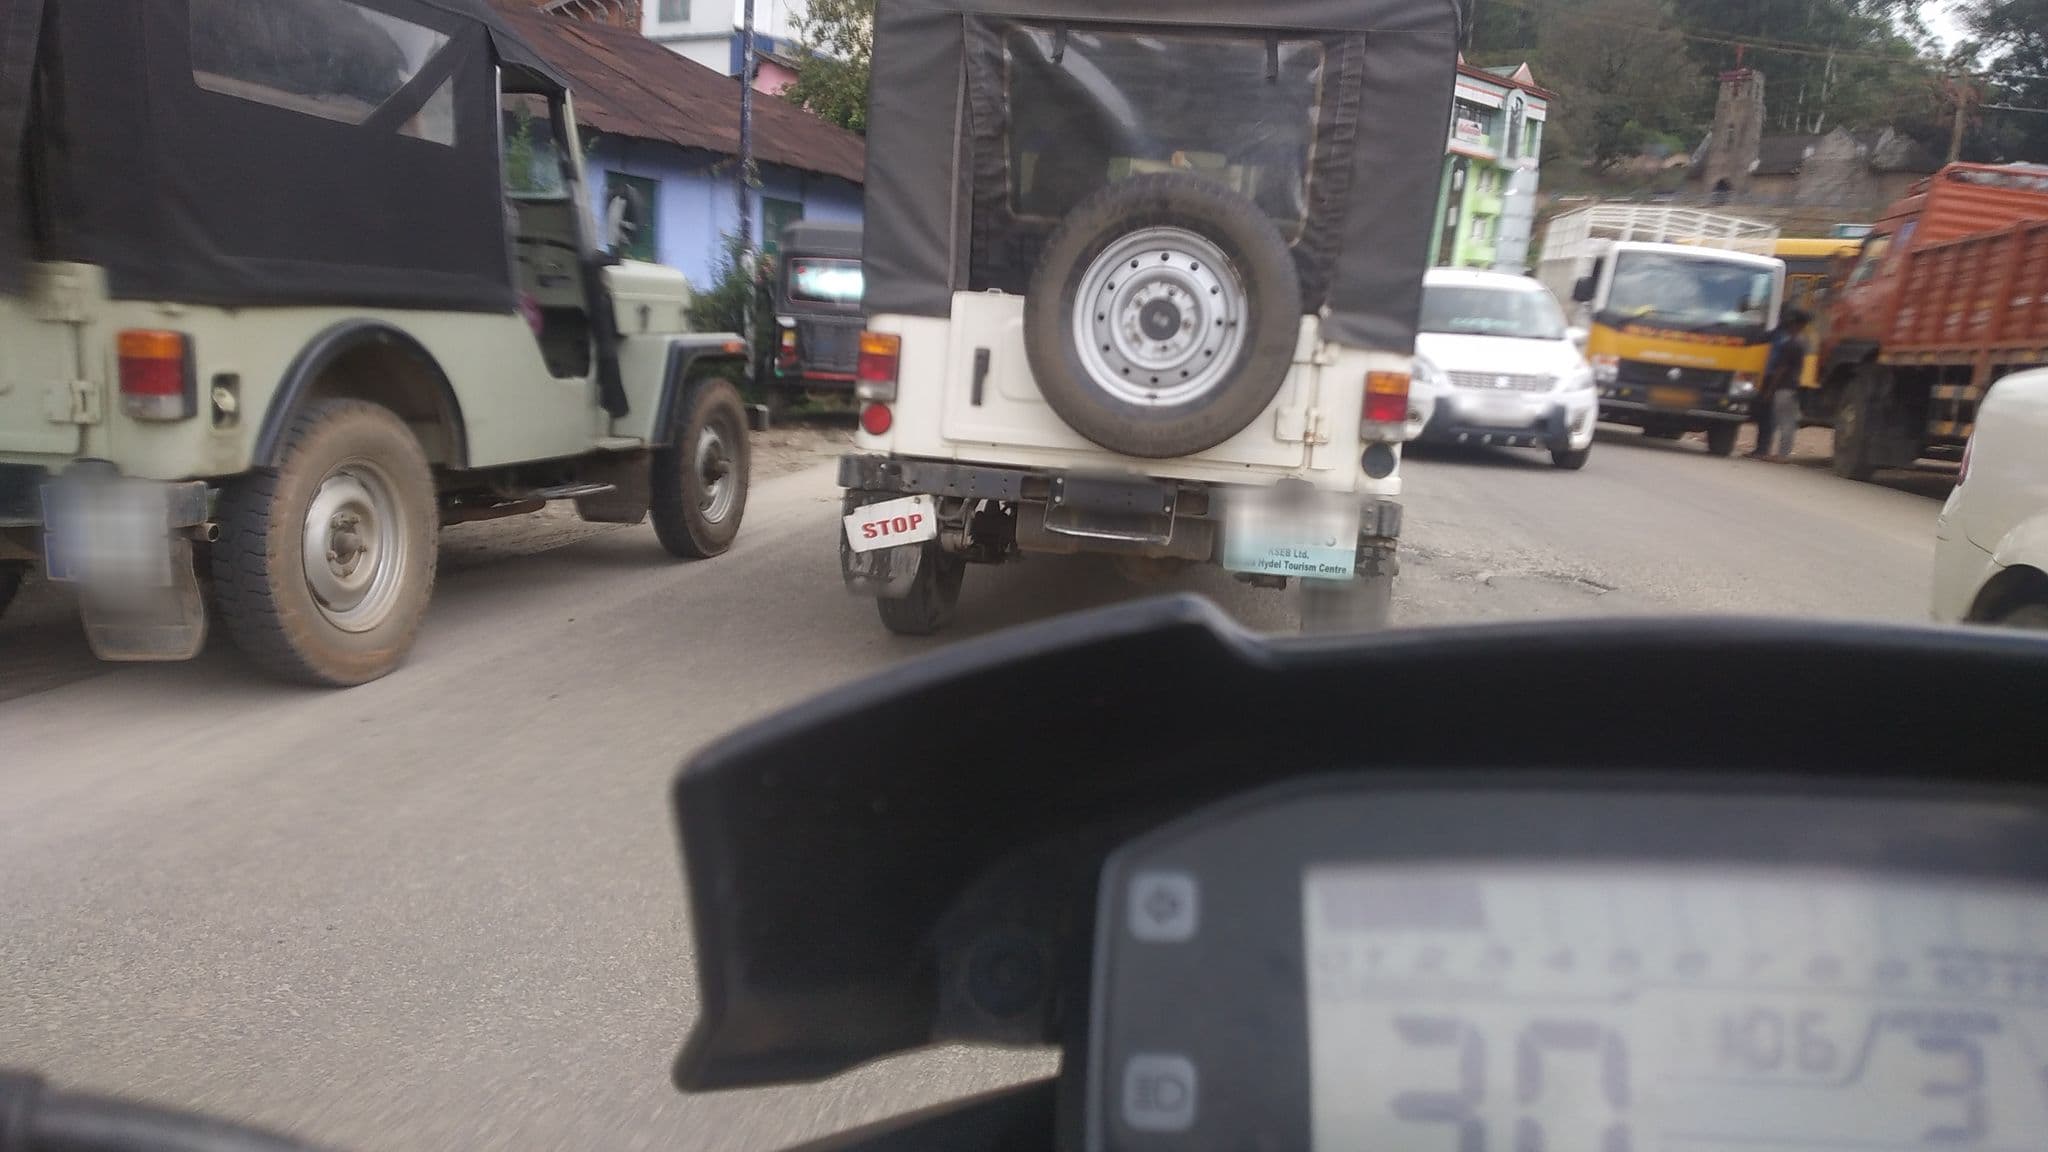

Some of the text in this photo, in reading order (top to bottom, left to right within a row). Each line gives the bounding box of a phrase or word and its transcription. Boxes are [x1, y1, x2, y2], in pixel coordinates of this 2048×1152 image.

[862, 514, 922, 539] STOP
[1293, 549, 1310, 560] Ltd.
[1258, 558, 1281, 570] Hydel
[1285, 560, 1317, 571] Tourism
[1319, 563, 1347, 574] Centre
[1914, 1034, 1989, 1143] 3
